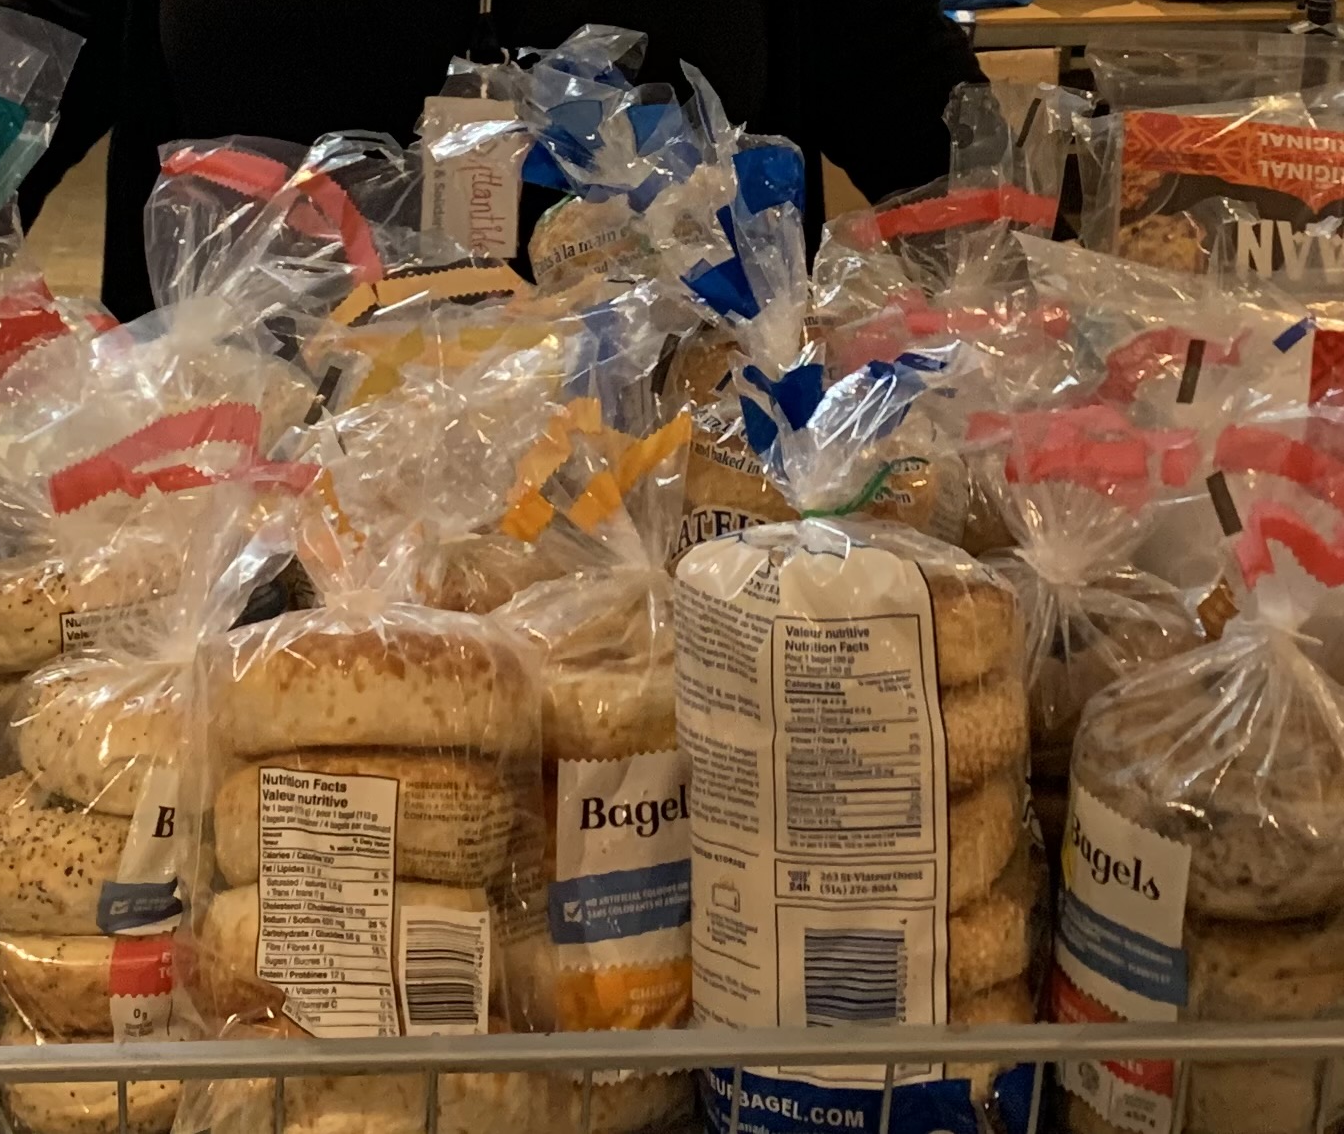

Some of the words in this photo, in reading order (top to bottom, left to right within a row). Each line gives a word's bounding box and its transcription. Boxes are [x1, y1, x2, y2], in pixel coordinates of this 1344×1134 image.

[711, 444, 746, 470] baked
[747, 462, 761, 475] in
[785, 625, 823, 639] Valeur
[824, 626, 870, 639] nutritive
[785, 639, 837, 654] Nutrition
[839, 640, 870, 654] Facts
[262, 773, 310, 790] Nutrition
[312, 777, 347, 794] Facts
[297, 794, 349, 810] nutritive
[579, 783, 691, 839] Bagel
